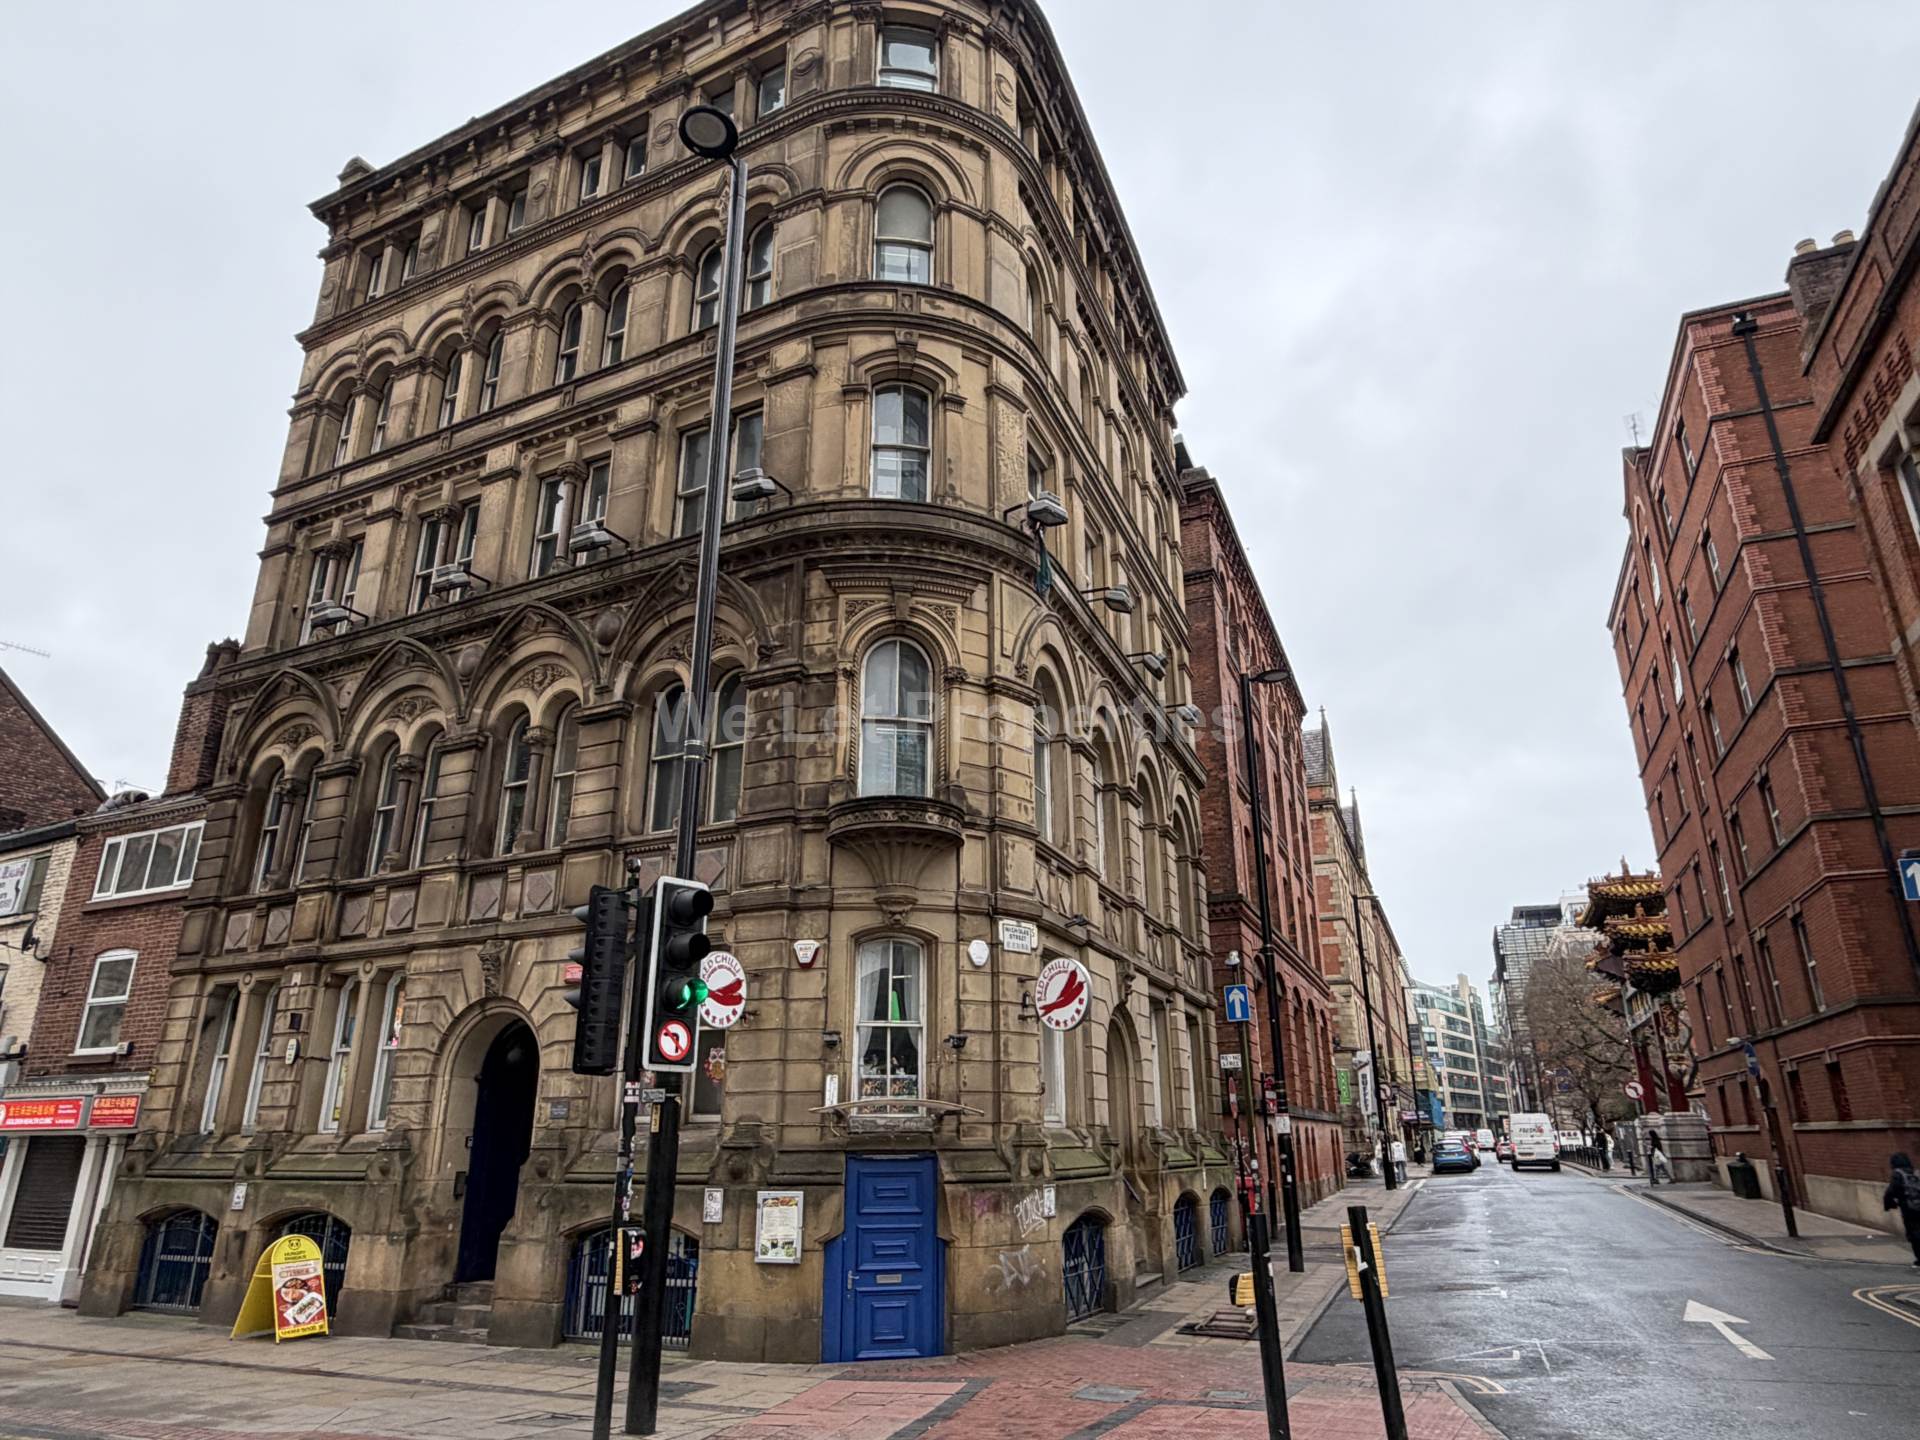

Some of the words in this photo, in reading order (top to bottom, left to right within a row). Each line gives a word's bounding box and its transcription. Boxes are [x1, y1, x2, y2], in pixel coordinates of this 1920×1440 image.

[714, 954, 741, 975] CHILLI
[1036, 980, 1045, 1002] RED
[1042, 960, 1070, 980] CHILLI
